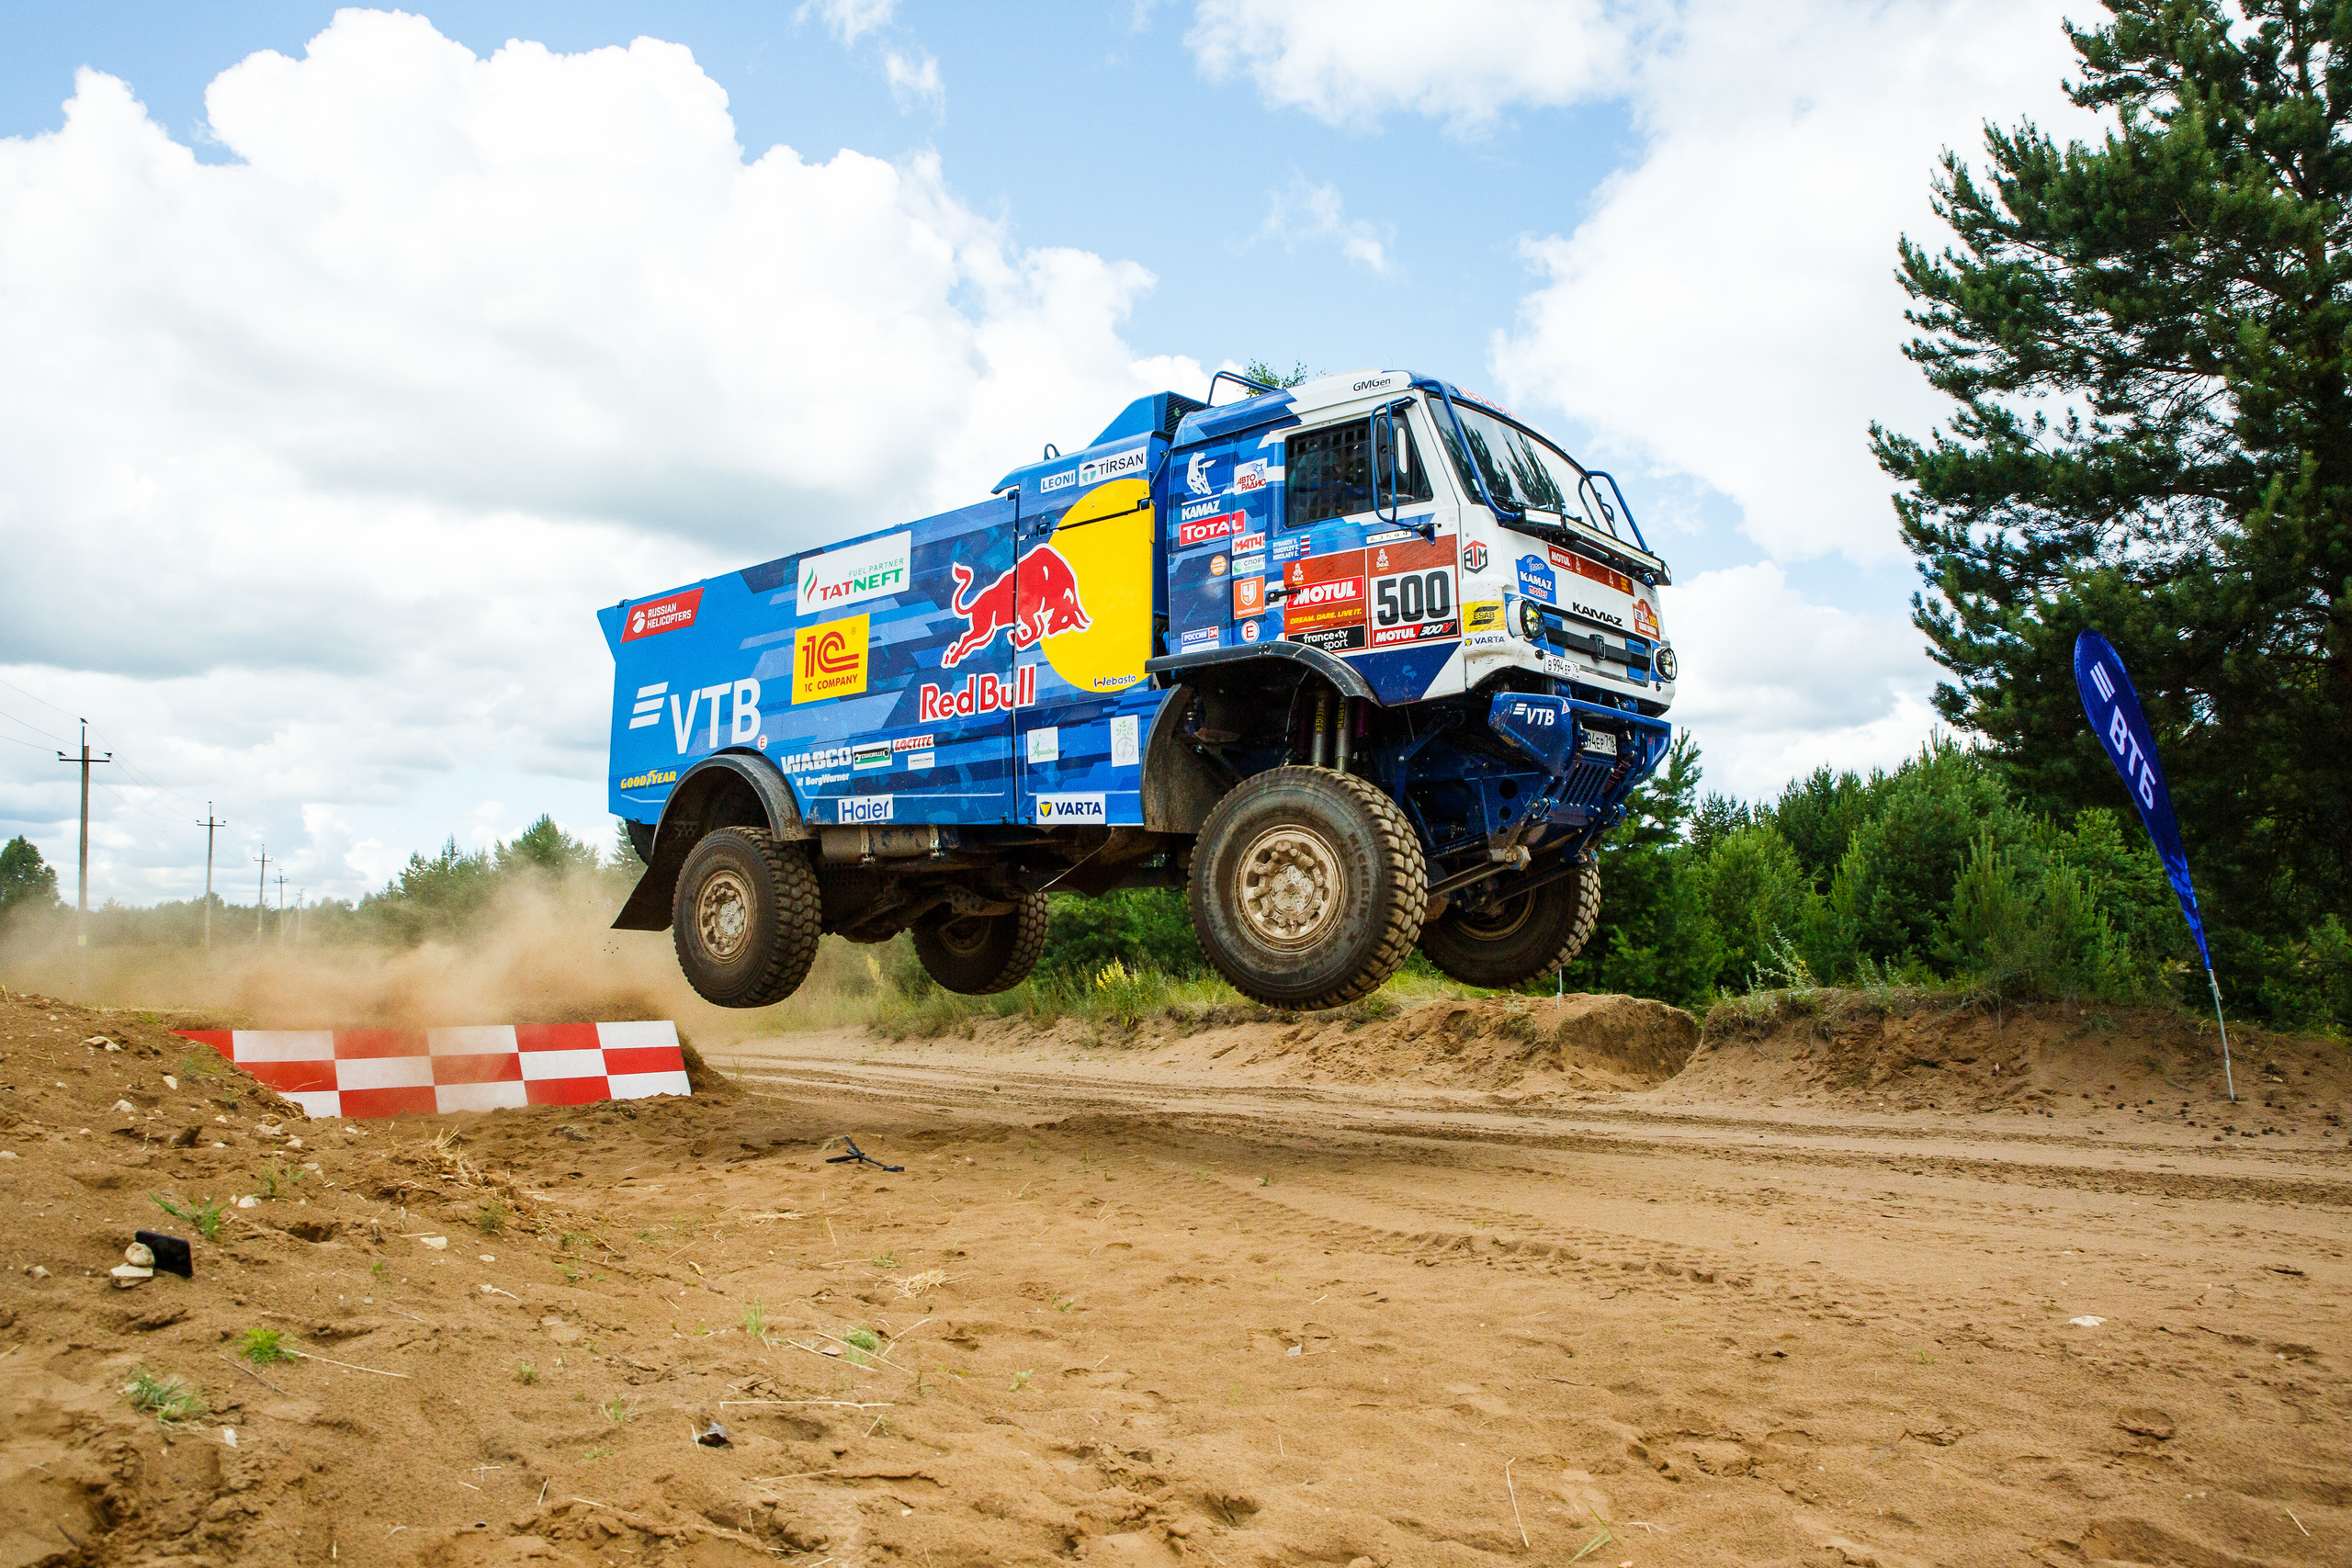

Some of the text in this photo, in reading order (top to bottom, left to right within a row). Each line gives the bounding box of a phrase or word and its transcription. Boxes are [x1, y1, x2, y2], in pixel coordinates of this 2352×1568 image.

[1352, 378, 1391, 392] GMGen
[1042, 472, 1074, 491] LEONI
[1182, 500, 1220, 521] KAMAZ
[1182, 518, 1242, 540] TOTAL
[848, 558, 904, 579] FUEL PARTNER
[1551, 551, 1571, 567] MOTUL
[820, 567, 904, 602] TATNEFT
[1520, 570, 1553, 592] KAMAZ
[1293, 580, 1356, 605] MOTUL
[1376, 570, 1450, 626] 500
[647, 602, 677, 619] RUSSIAN
[647, 609, 692, 629] HELICOPTERS
[1289, 607, 1363, 625] DREAM. DARE. LIVE IT.
[1474, 611, 1495, 620] ESAB
[1572, 602, 1623, 627] KAMAZ
[1245, 626, 1254, 637] E
[1374, 621, 1455, 643] MOTUL 300V
[1474, 635, 1505, 645] VARTA
[1323, 637, 1349, 651] sport
[817, 673, 859, 691] COMPANY
[670, 677, 762, 755] VTB
[1526, 707, 1555, 727] VTB
[759, 738, 766, 749] E
[894, 736, 933, 751] LOCTITE
[781, 747, 853, 774] WABCO
[620, 770, 677, 789] GOODYEAR
[805, 773, 850, 786] BorgWarner
[842, 798, 889, 822] Haier
[1056, 801, 1102, 816] VARTA
